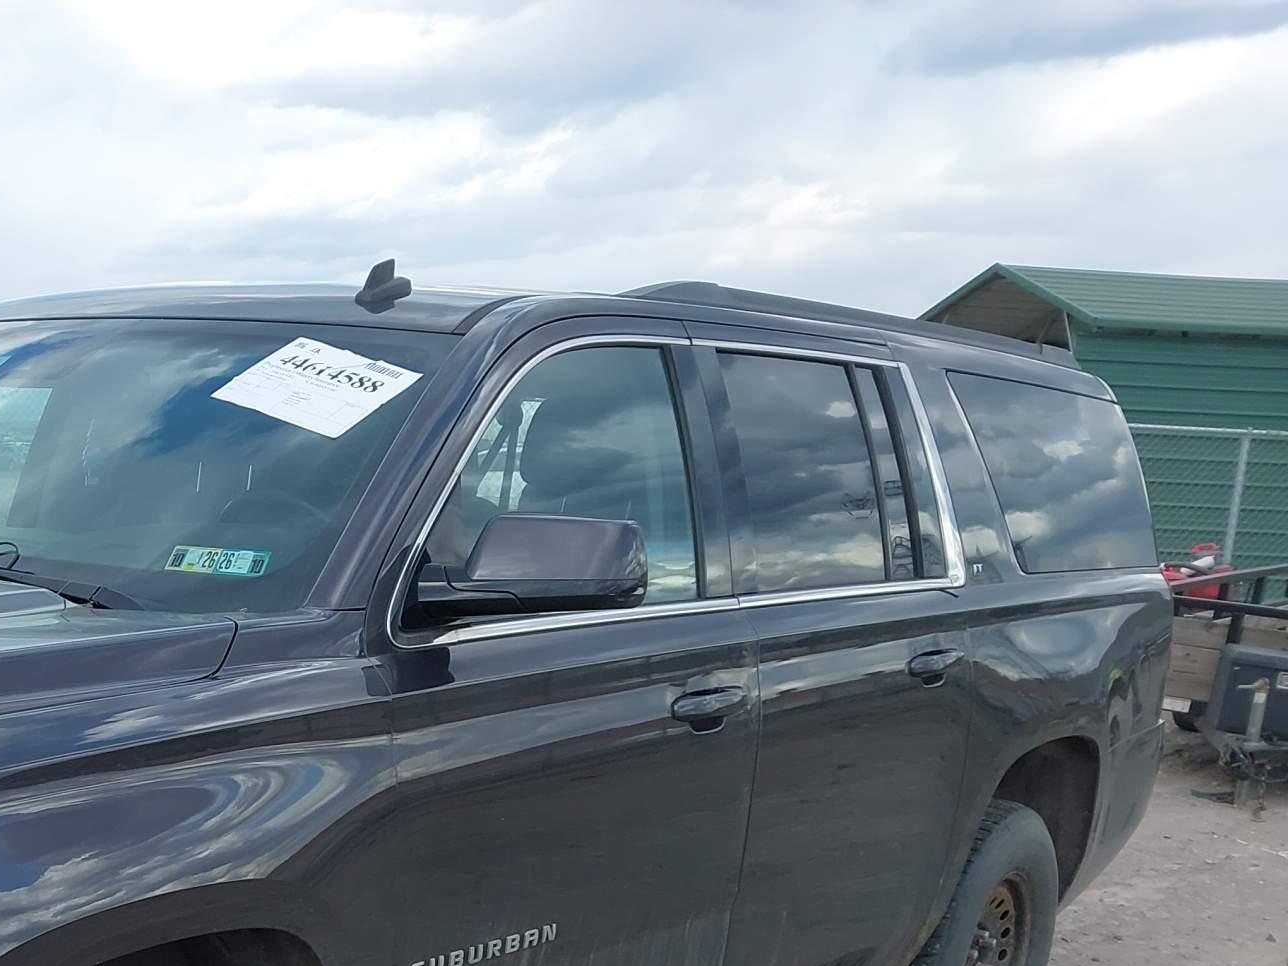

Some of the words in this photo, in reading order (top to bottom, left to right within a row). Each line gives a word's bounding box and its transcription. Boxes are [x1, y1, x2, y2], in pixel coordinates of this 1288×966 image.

[279, 355, 385, 393] 44614588
[201, 551, 219, 568] 26
[219, 552, 236, 570] 26
